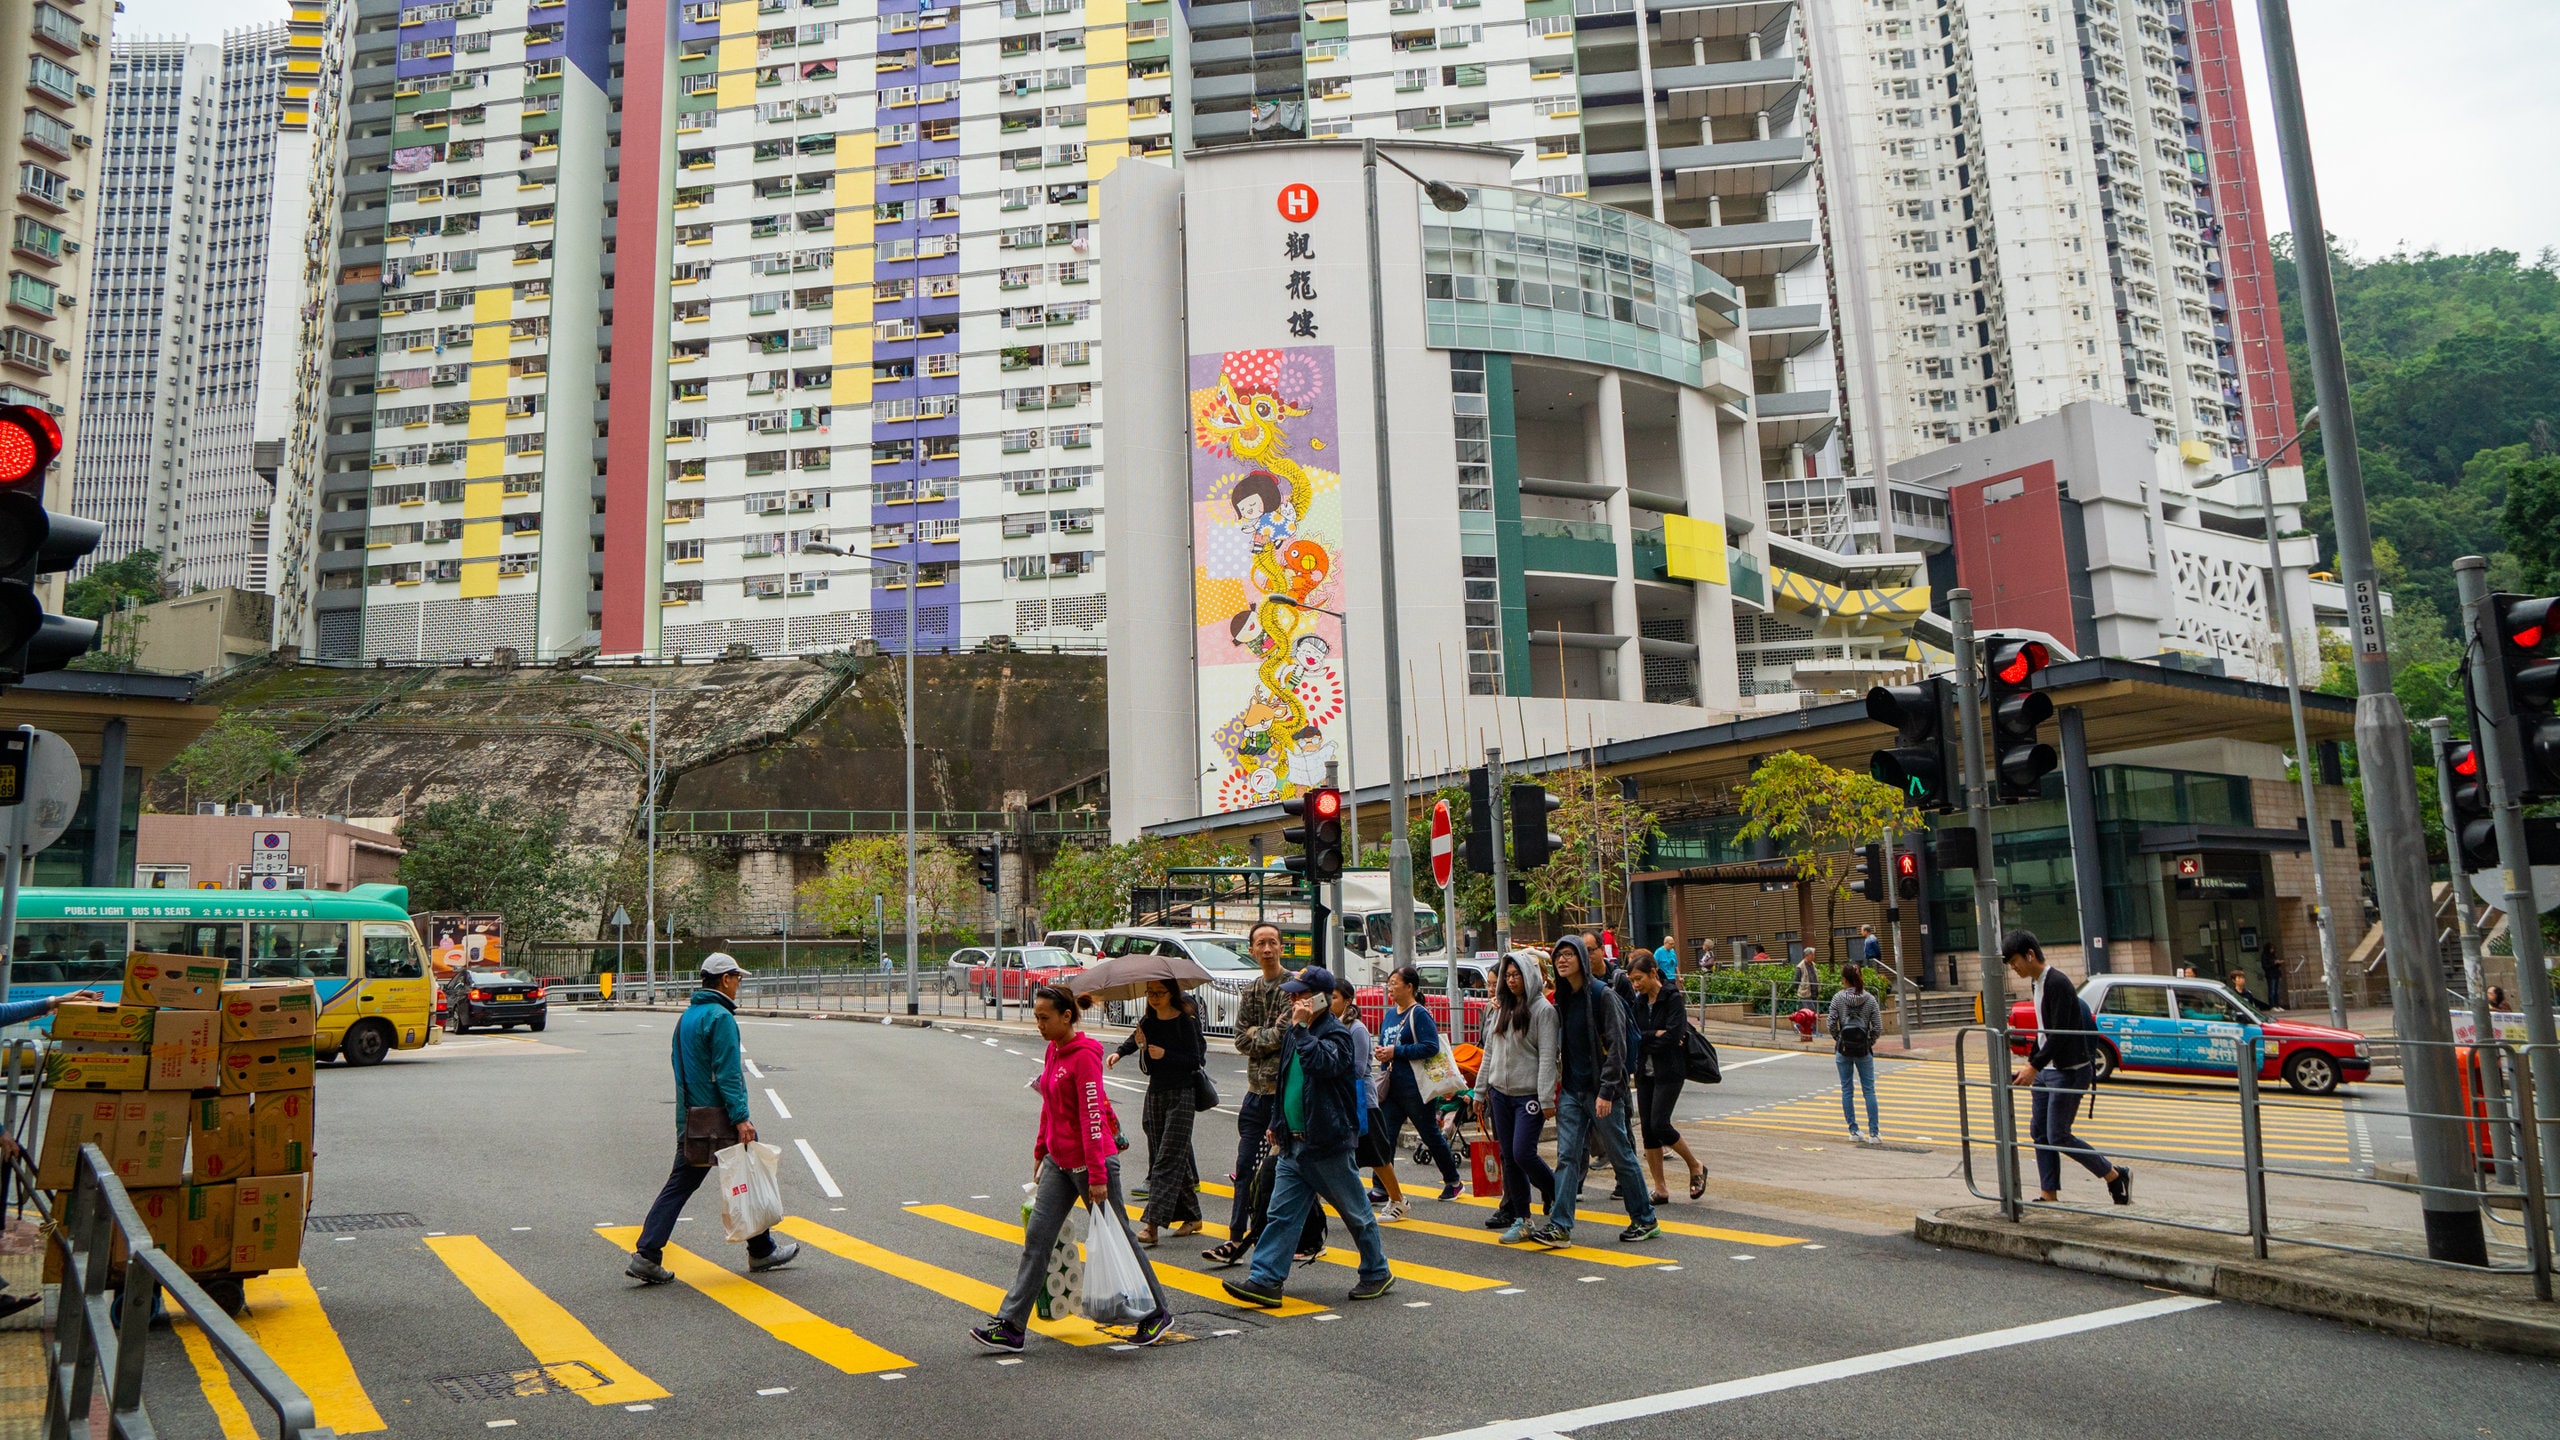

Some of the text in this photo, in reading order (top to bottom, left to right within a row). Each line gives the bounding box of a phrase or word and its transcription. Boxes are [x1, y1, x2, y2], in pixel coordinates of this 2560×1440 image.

[1287, 189, 1309, 215] H
[1284, 231, 1318, 338] 觀龍樓
[2356, 582, 2378, 653] 50568 B
[64, 906, 191, 916] PUBLIC LIGHT BUS 16 SEATS
[1085, 1081, 1102, 1140] HOLLISTER
